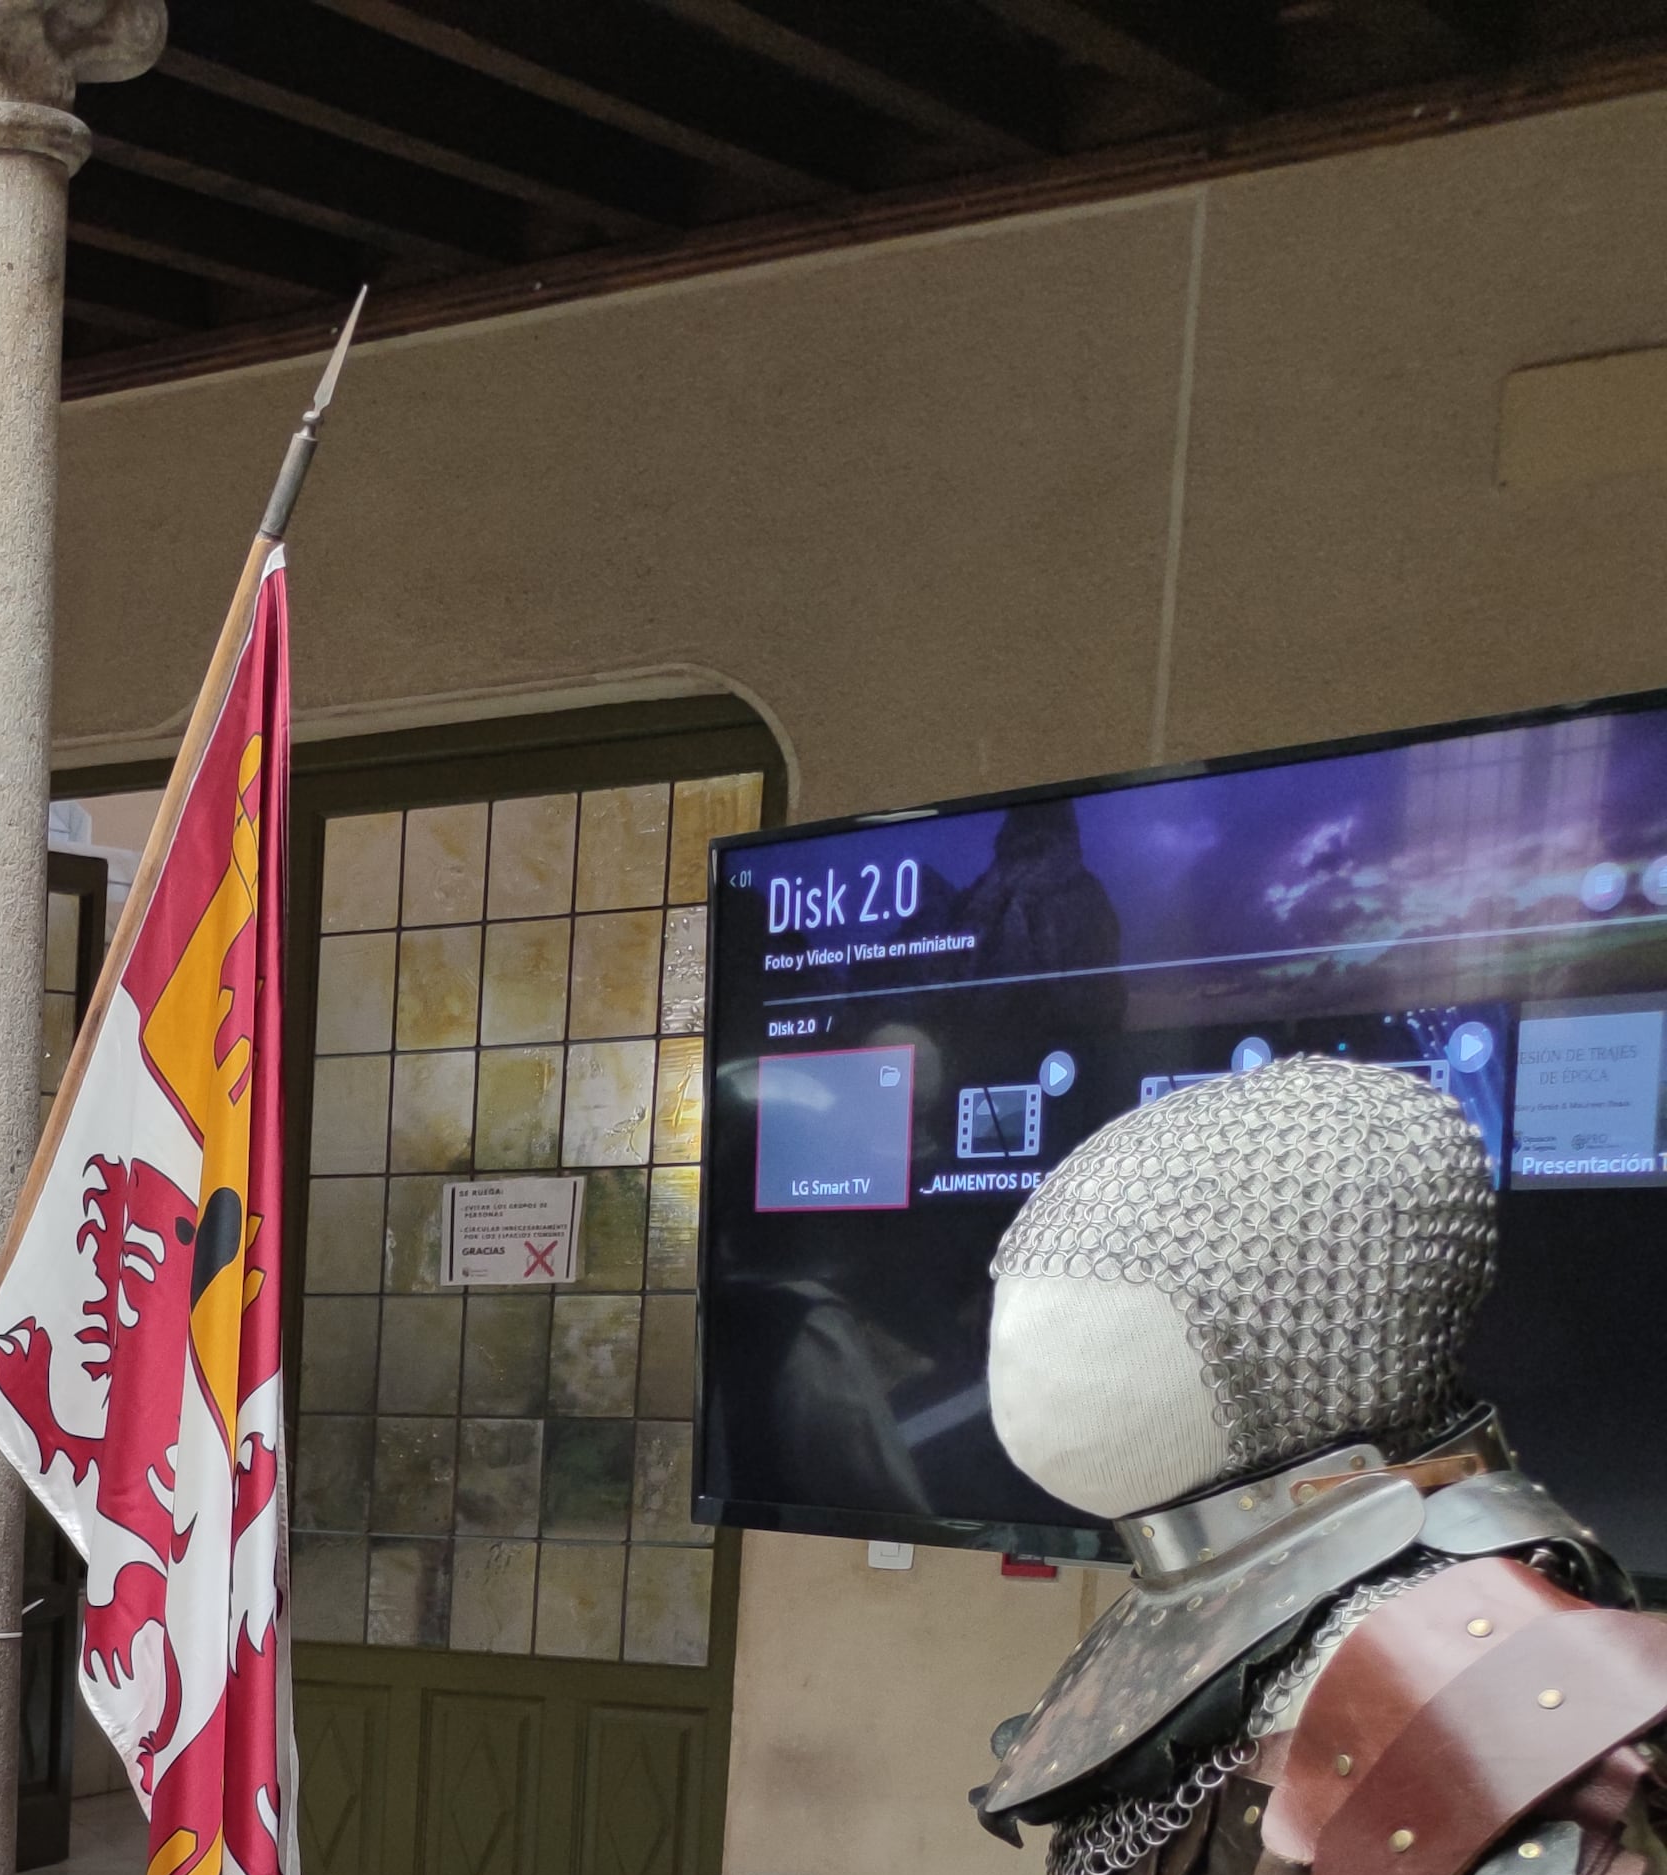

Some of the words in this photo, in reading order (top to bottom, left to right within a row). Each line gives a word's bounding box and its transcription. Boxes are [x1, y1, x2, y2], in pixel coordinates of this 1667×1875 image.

[769, 868, 847, 934] Disk
[859, 858, 918, 922] 2.0
[764, 953, 794, 971] Foto
[796, 954, 805, 971] y
[854, 944, 886, 961] Vista
[889, 942, 906, 957] en
[909, 934, 975, 955] miniatura
[769, 1021, 794, 1037] Disk
[797, 1019, 816, 1035] 2.0
[1566, 1047, 1587, 1062] DE
[1539, 1071, 1557, 1085] DE
[1522, 1152, 1654, 1175] Presentación
[792, 1180, 809, 1196] LG
[812, 1178, 850, 1195] Smart
[851, 1178, 870, 1194] TV
[461, 1246, 506, 1256] GRACIAS
